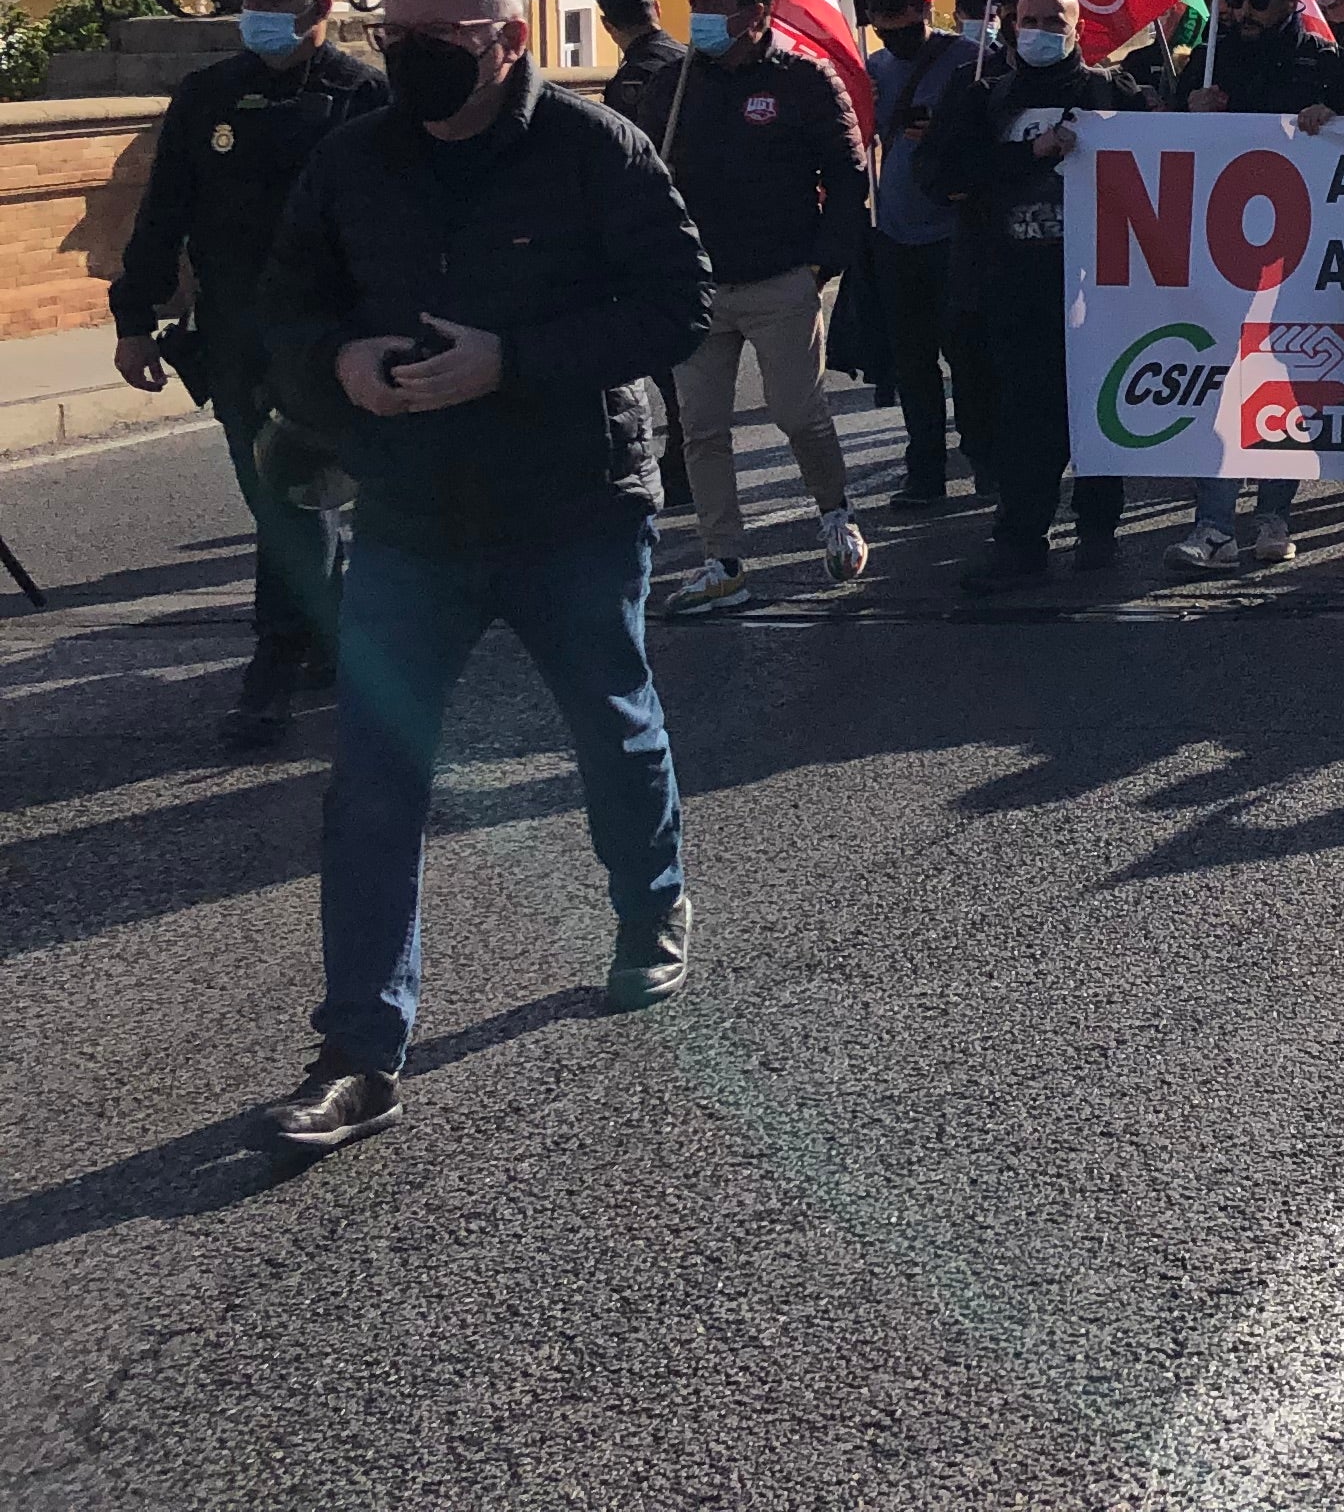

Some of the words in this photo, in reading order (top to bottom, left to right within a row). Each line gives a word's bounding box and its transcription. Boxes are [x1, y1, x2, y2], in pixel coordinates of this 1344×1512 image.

[748, 97, 776, 111] UGT
[1096, 149, 1312, 292] NO
[1124, 362, 1231, 407] CSIF
